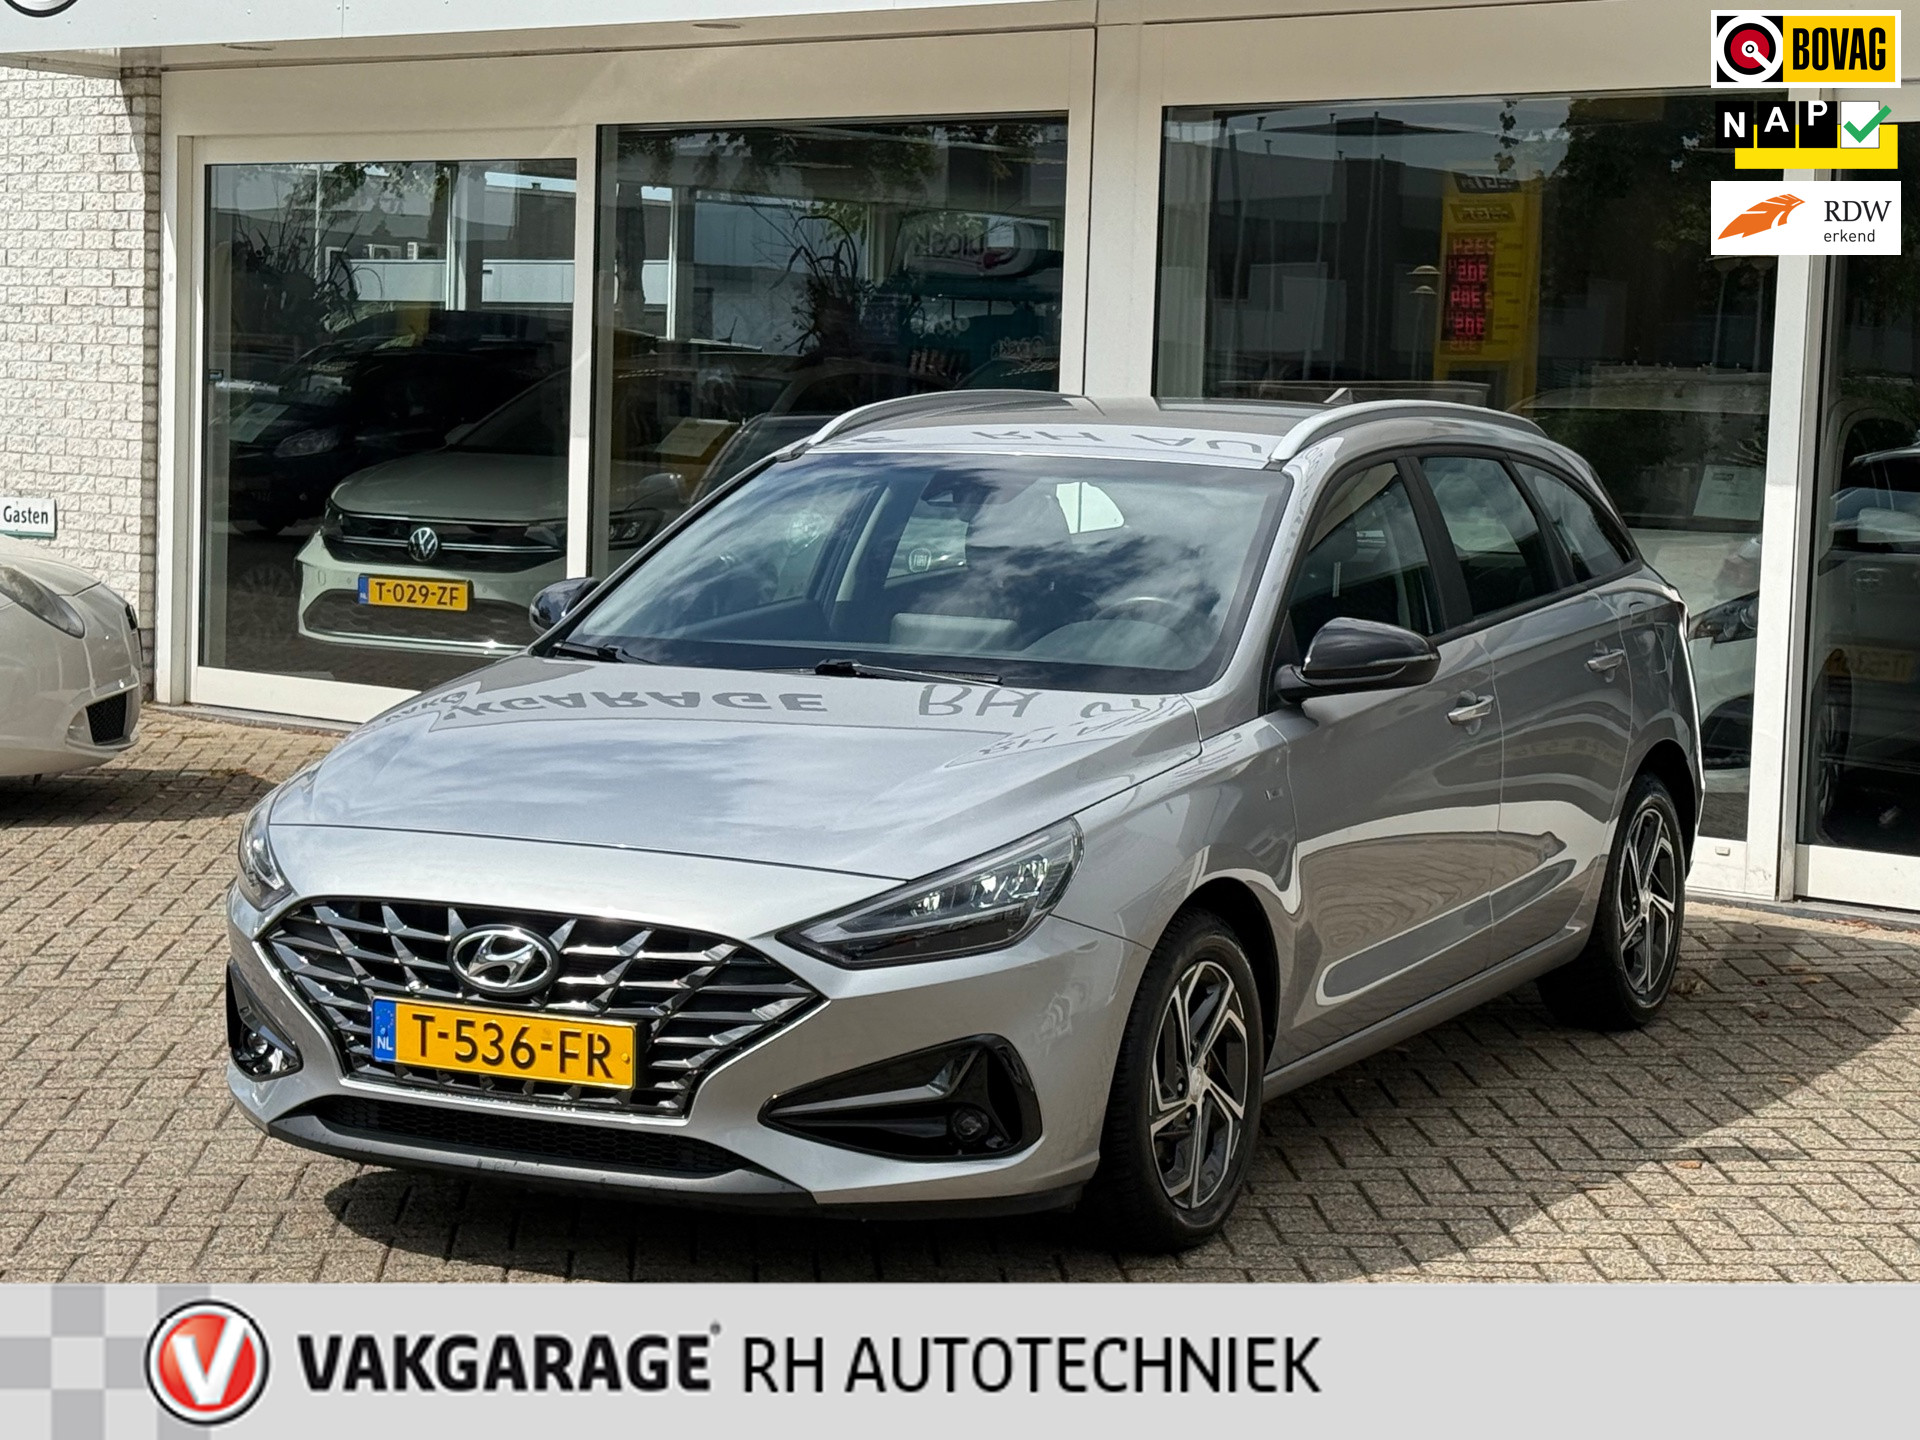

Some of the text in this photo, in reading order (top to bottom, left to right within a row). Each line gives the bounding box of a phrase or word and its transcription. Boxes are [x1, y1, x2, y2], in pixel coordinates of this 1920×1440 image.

[3, 505, 49, 525] Gasten
[375, 582, 460, 607] T-029-ZF
[376, 1013, 615, 1080] NL T-536-FR
